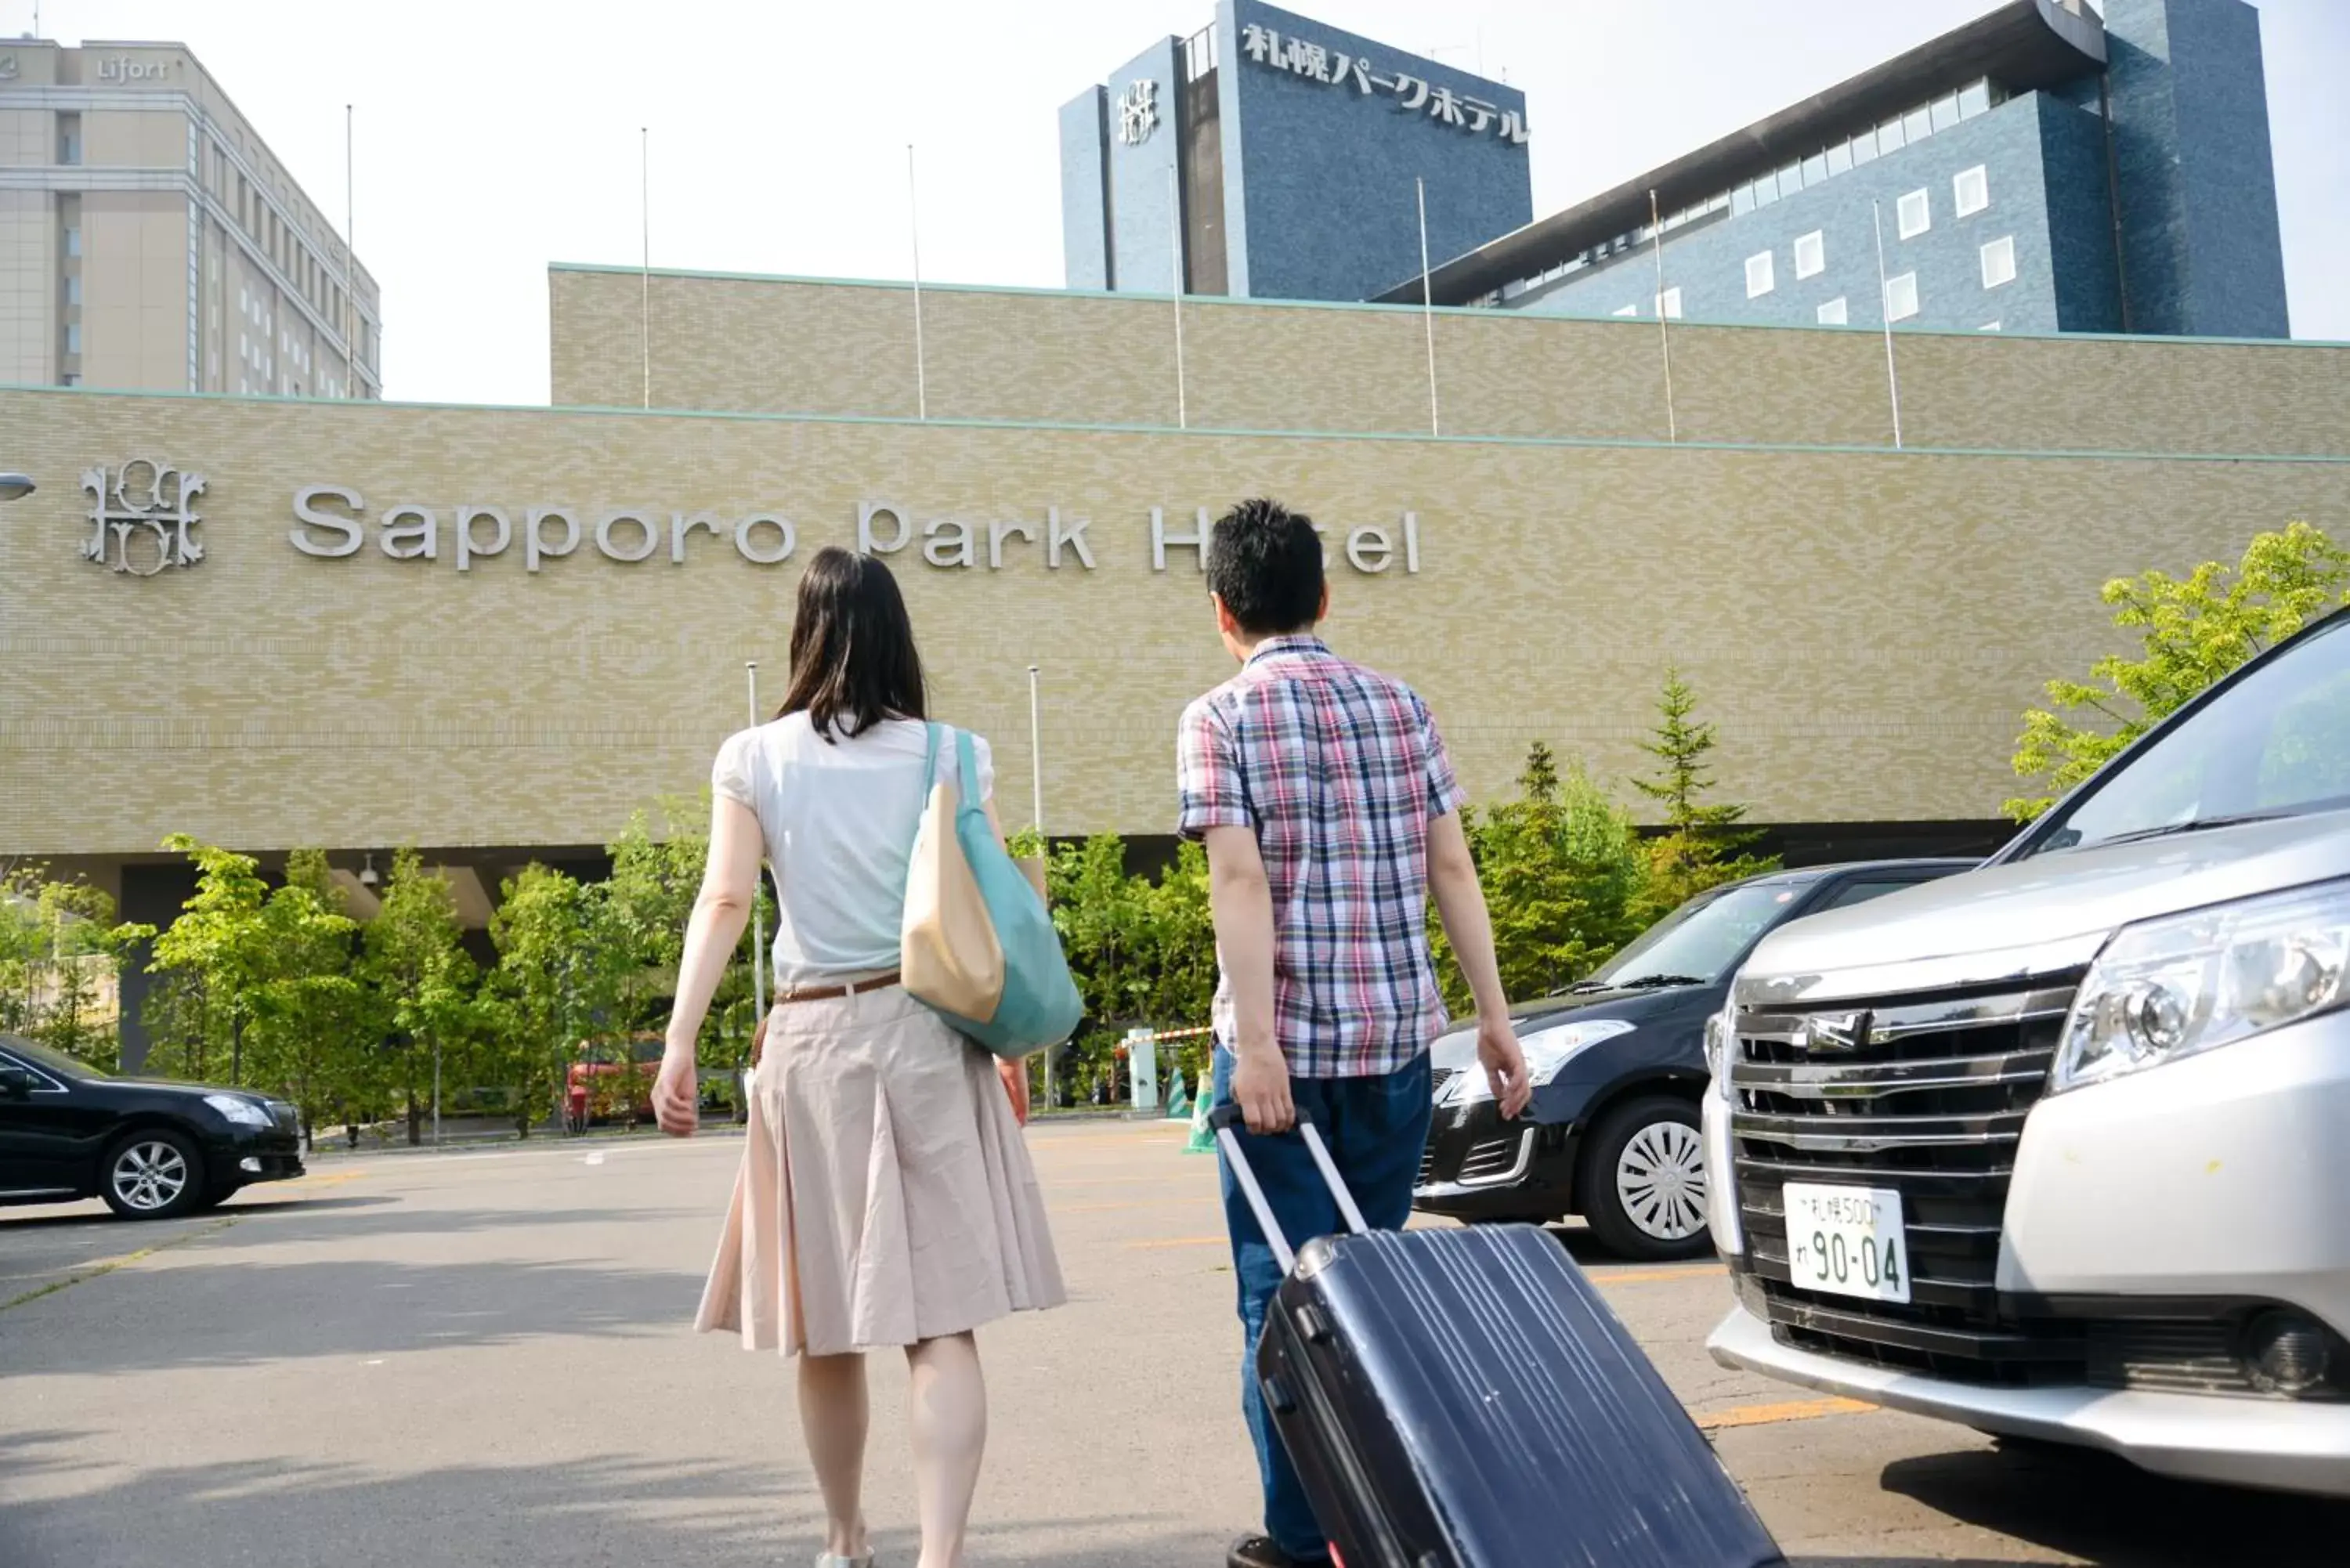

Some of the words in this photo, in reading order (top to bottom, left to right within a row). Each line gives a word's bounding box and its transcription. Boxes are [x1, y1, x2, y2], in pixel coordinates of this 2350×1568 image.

[97, 55, 168, 86] Lifort
[1242, 23, 1530, 144] 札幌パークホテル
[288, 483, 796, 573] Sapporo
[1143, 507, 1419, 573] Hel
[1813, 1230, 1900, 1292] 90-04
